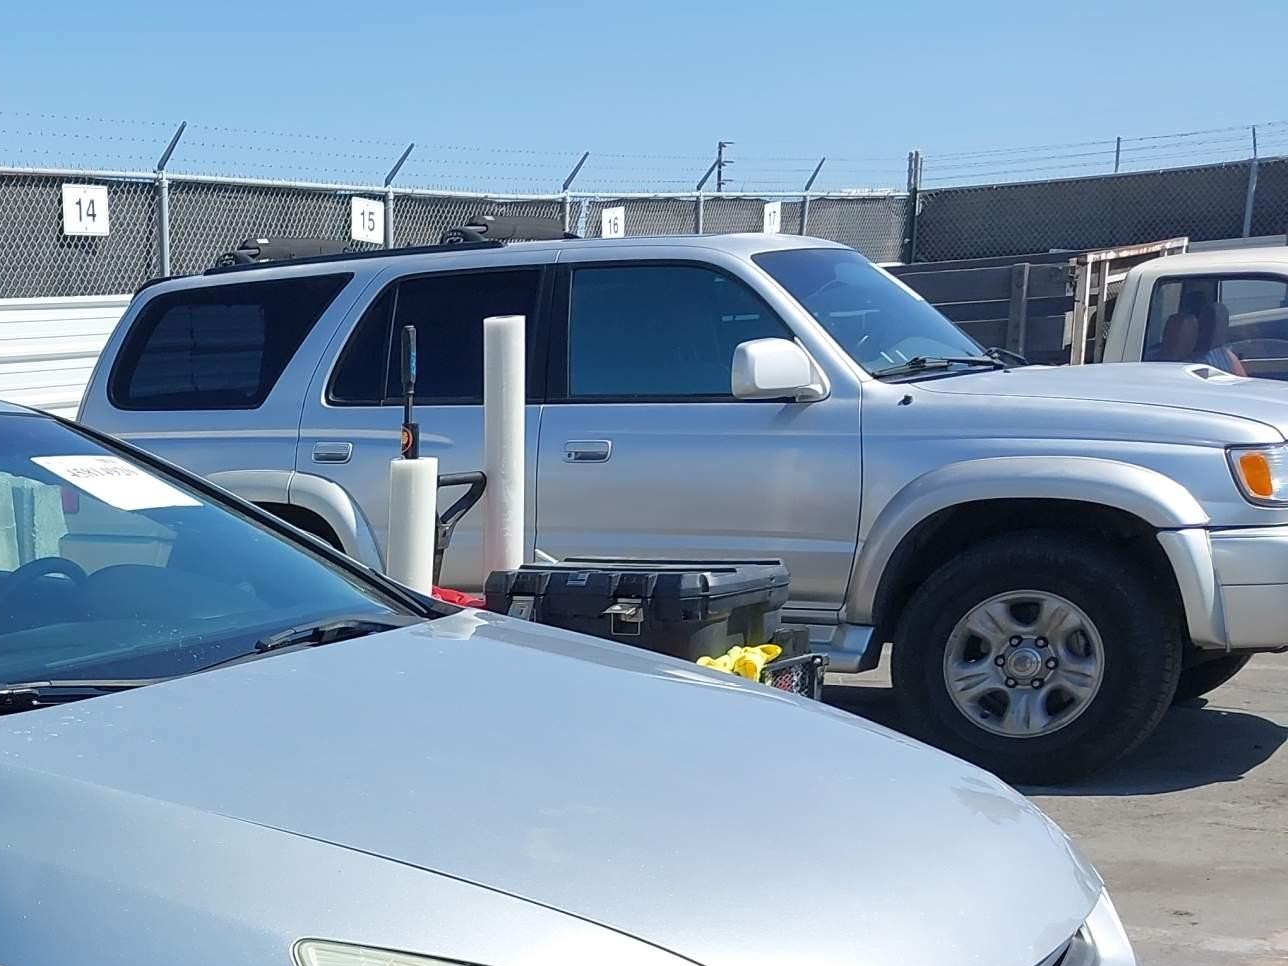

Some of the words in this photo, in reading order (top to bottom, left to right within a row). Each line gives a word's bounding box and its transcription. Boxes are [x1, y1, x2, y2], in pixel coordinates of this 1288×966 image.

[75, 197, 97, 222] 14
[360, 208, 375, 232] 15
[768, 210, 777, 227] 17
[608, 215, 619, 235] 16
